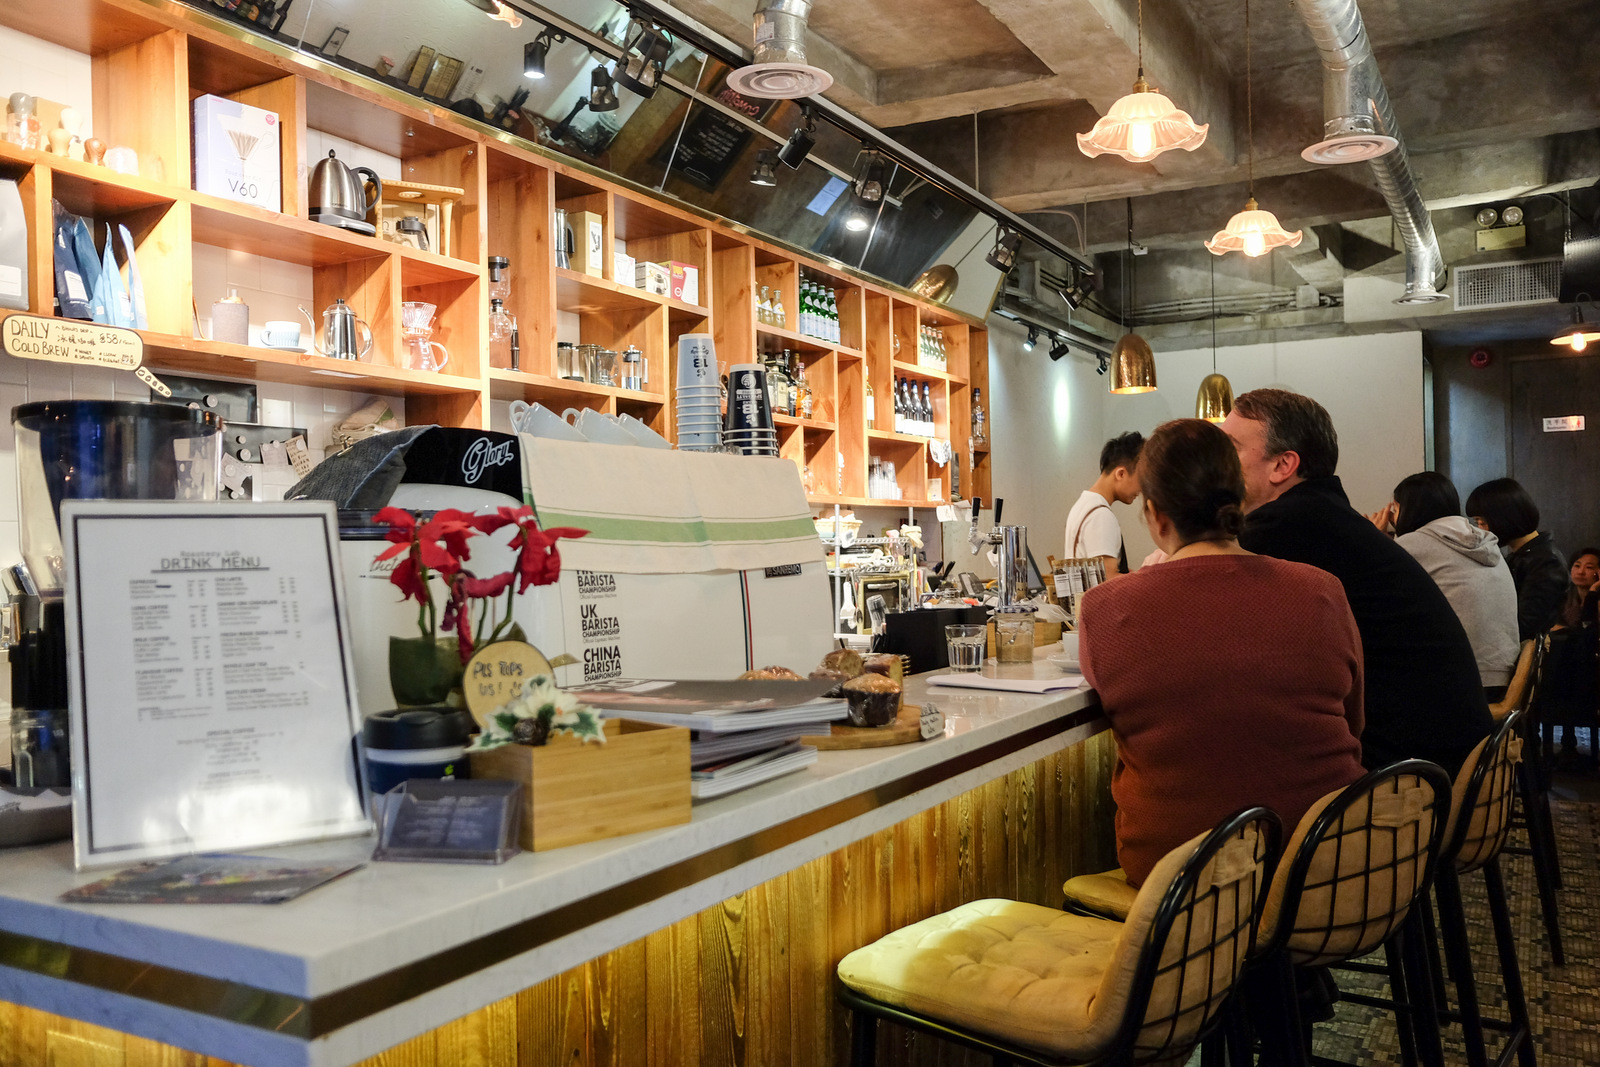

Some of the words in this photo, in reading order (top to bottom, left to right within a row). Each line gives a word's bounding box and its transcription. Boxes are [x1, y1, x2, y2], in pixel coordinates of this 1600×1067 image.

[228, 178, 258, 198] V60
[11, 320, 50, 339] DAILY
[12, 338, 40, 354] COLD
[42, 341, 70, 358] BREW
[462, 437, 514, 484] Glory
[160, 558, 211, 570] DRINK
[221, 556, 261, 568] MENU
[578, 575, 616, 587] BARISTA
[580, 604, 598, 619] UK
[582, 617, 620, 631] BARISTA
[582, 628, 620, 637] CHAMPIONSHIP
[584, 645, 621, 663] CHINA
[584, 660, 622, 675] BARISTA
[584, 671, 622, 682] CHAMPIONSHIP
